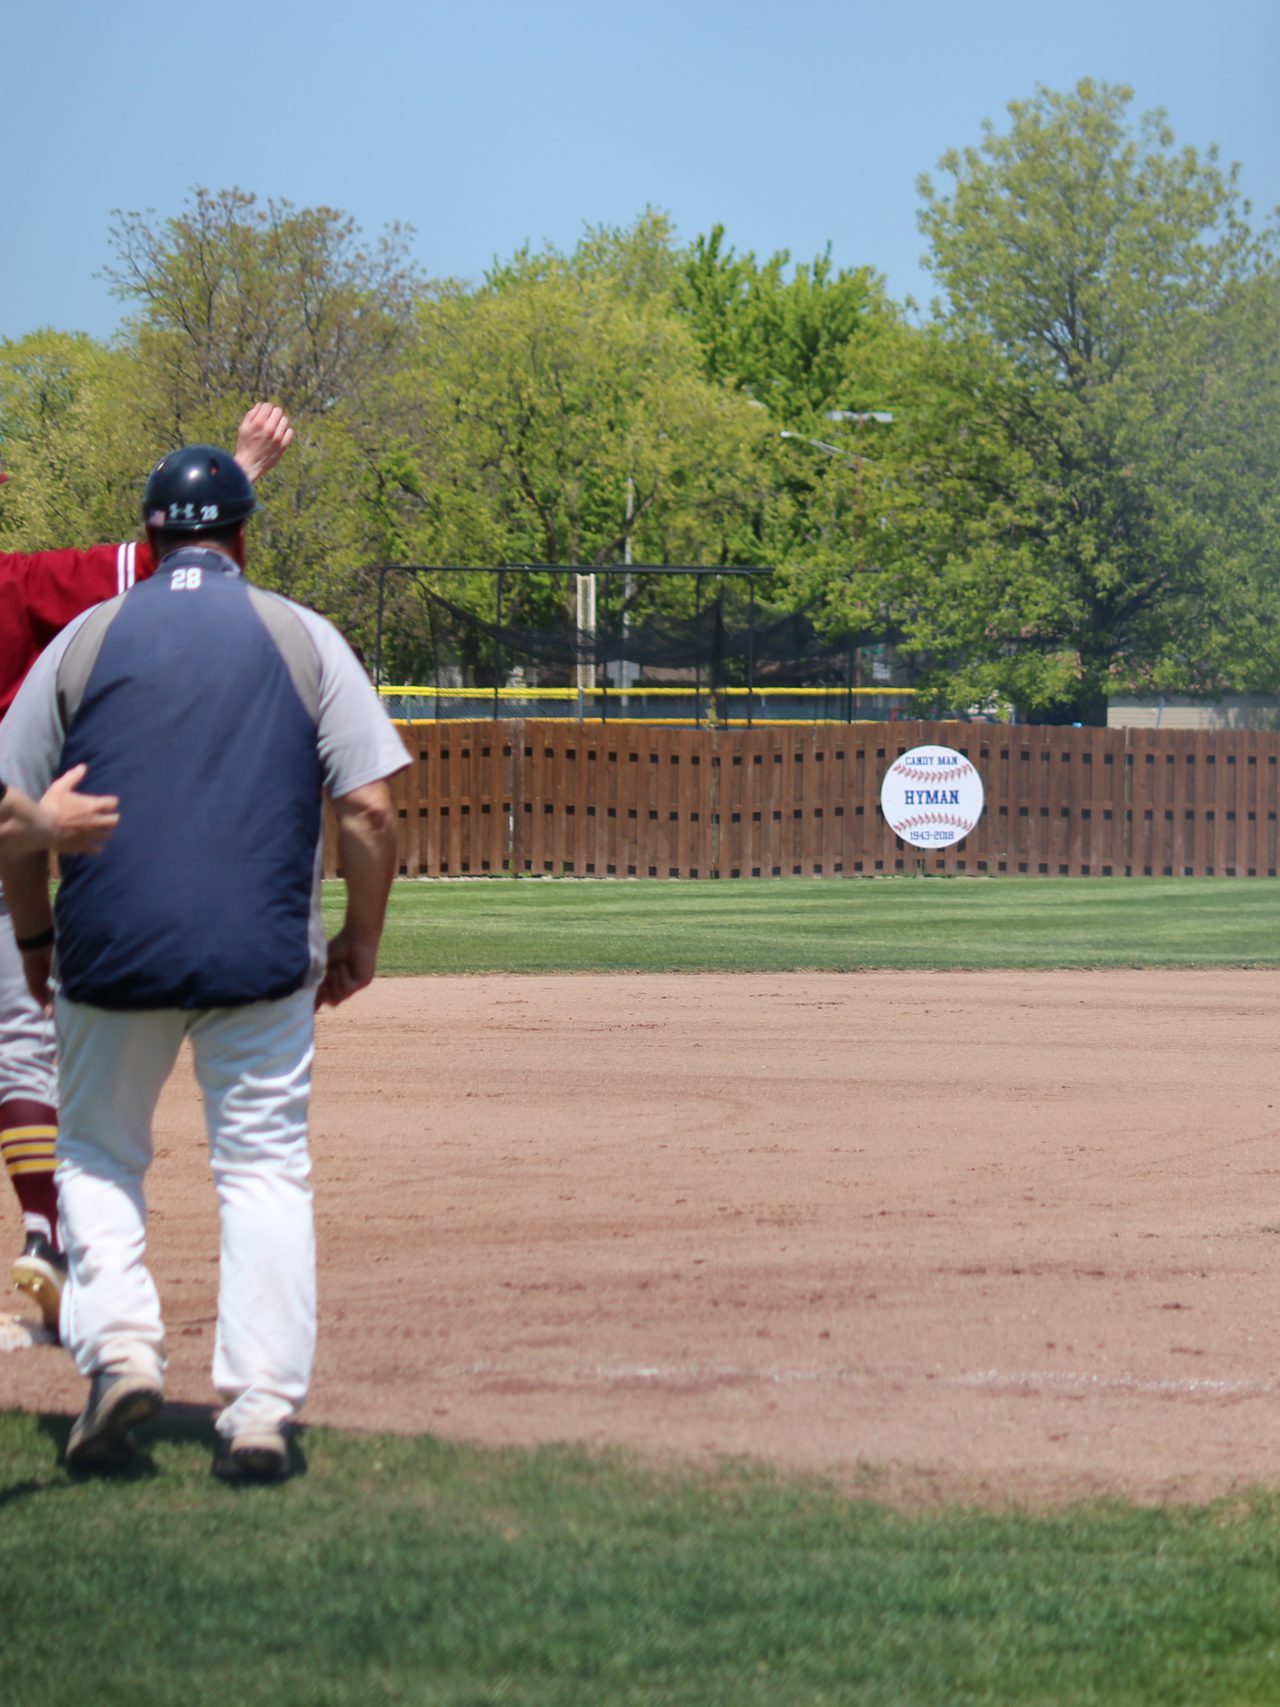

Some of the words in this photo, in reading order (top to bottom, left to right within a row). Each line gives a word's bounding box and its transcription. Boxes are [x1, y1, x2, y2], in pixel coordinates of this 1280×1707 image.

[200, 504, 219, 521] 28
[170, 567, 202, 591] 28
[905, 756, 935, 766] CANDY
[937, 756, 958, 766] MAN
[904, 790, 960, 805] HYMAN
[910, 831, 954, 841] 1943-2018
